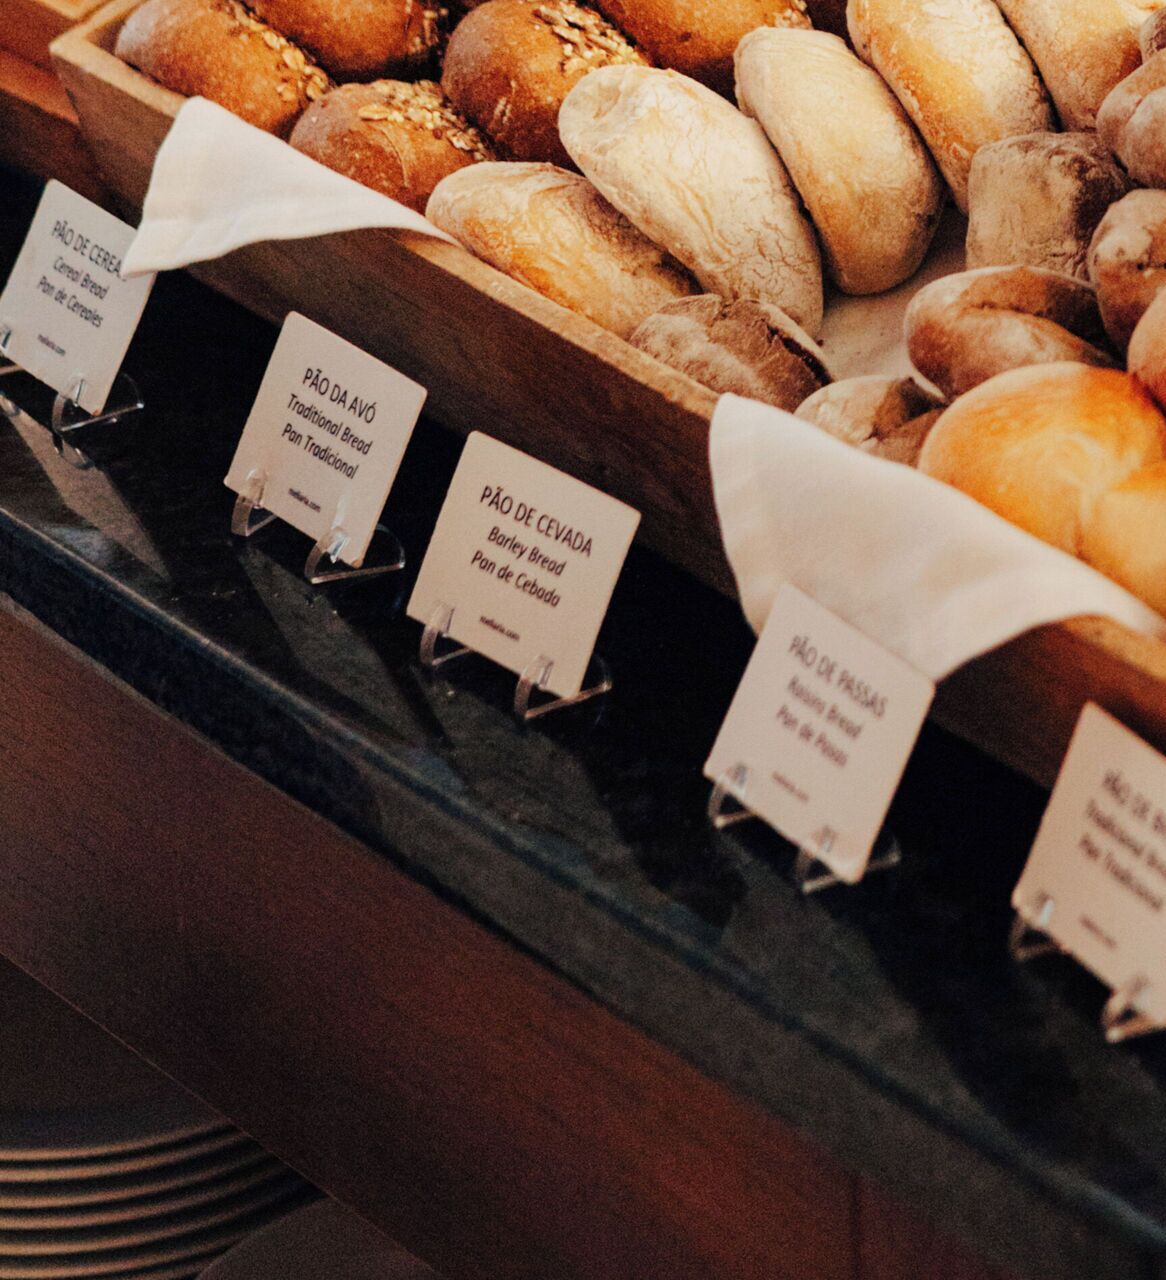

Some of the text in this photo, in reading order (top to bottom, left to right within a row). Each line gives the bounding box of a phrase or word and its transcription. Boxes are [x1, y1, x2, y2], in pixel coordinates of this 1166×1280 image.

[52, 220, 127, 281] PÃO DE CEREA
[53, 256, 110, 300] Cereal Bread
[38, 276, 104, 328] Pan de Cereales
[302, 368, 377, 424] PÃO DA AVÓ
[281, 423, 359, 479] Pan Tradicional
[287, 393, 373, 456] Traditional Bread
[480, 485, 593, 558] PÃO DE CEVADA
[471, 550, 561, 608] Pan de Cebada
[488, 526, 567, 576] Barley Bread
[789, 635, 888, 719] PÃO DE PASSAS
[776, 704, 799, 732] Pan
[798, 723, 814, 742] de
[826, 703, 864, 740] Bread
